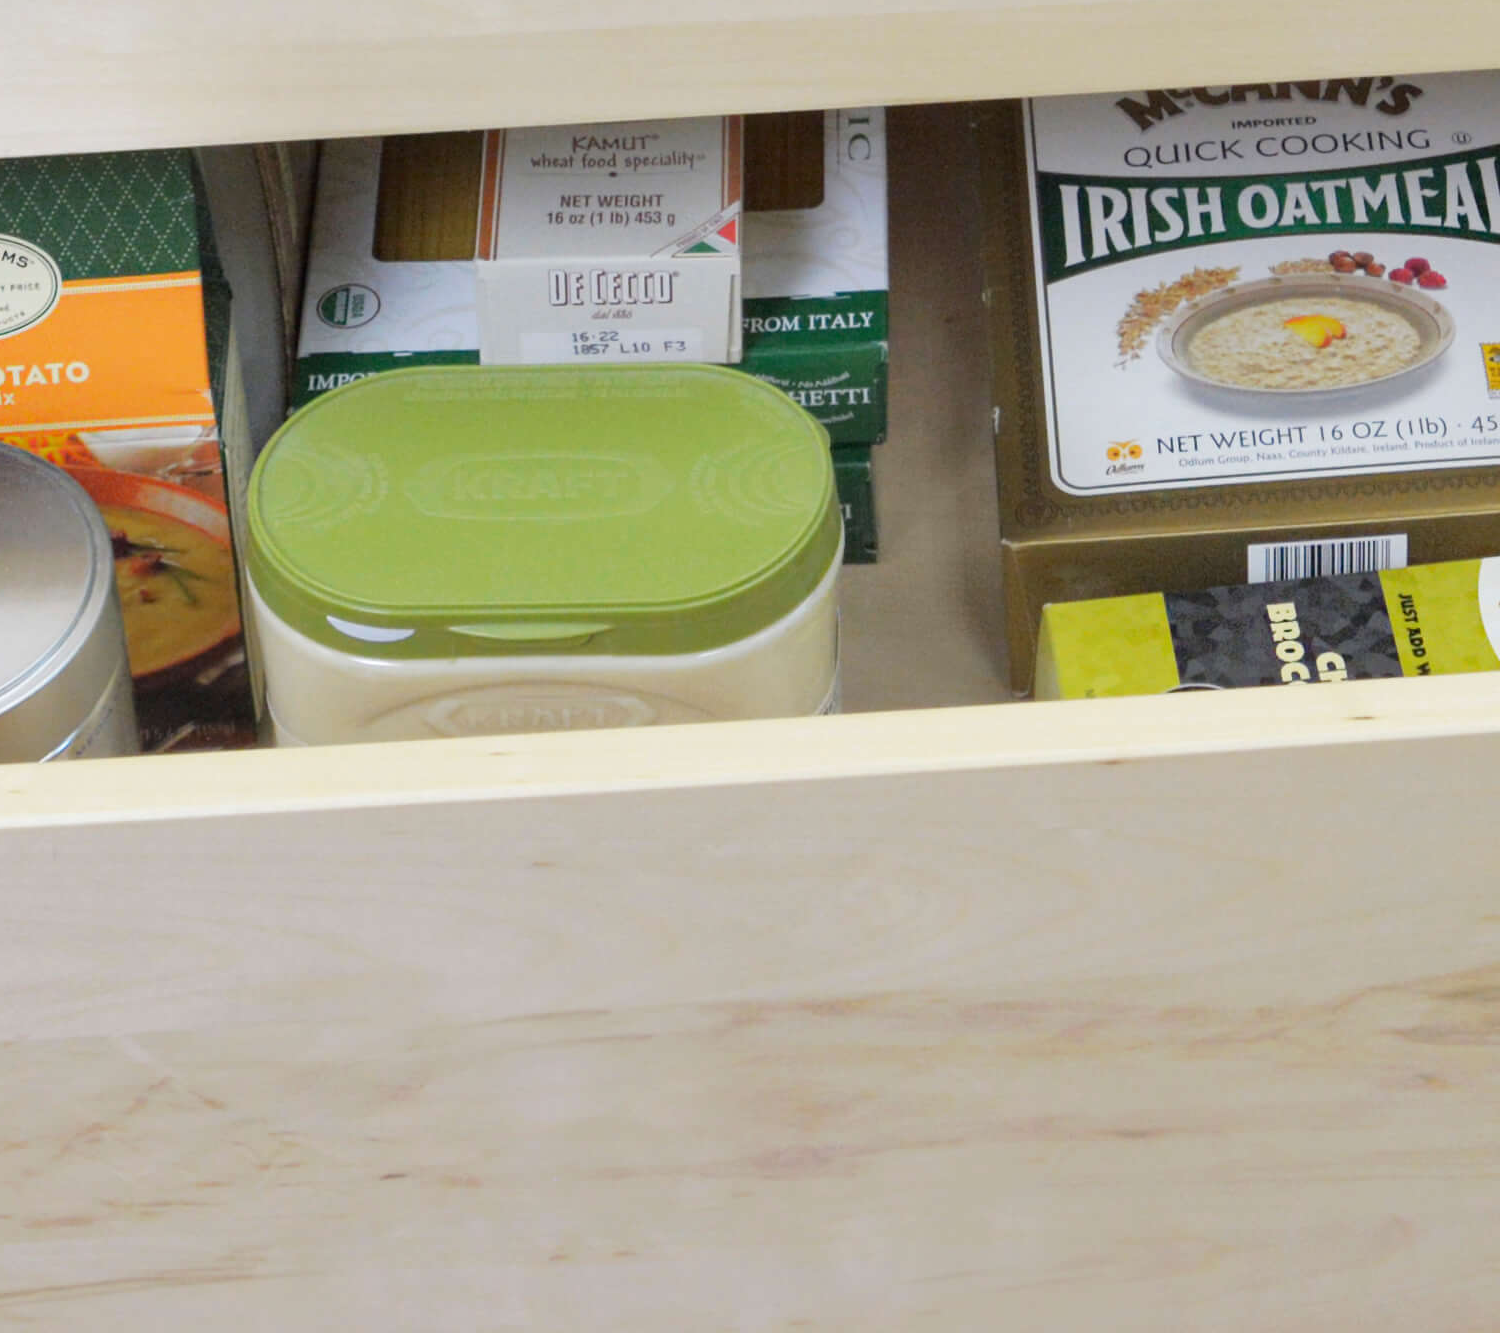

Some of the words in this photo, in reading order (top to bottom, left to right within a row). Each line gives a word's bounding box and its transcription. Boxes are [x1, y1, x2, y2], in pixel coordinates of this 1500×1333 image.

[1231, 115, 1317, 130] IMPORTED
[572, 135, 652, 154] KAMUT
[1123, 140, 1243, 169] QUICK
[1256, 129, 1431, 159] COOKING
[530, 154, 574, 169] wheat
[582, 153, 617, 169] food
[560, 194, 593, 207] NET
[598, 194, 664, 208] WEIGHT
[547, 212, 564, 225] 16
[568, 214, 585, 225] oz
[634, 211, 663, 225] 453
[667, 213, 676, 226] g
[1059, 184, 1227, 269] IRISH
[589, 268, 674, 306] CECCO
[742, 316, 800, 333] FROM
[808, 312, 873, 331] ITALY
[1156, 434, 1203, 454] NET
[1209, 425, 1308, 450] WEIGHT
[1318, 425, 1343, 442] 16
[1352, 420, 1388, 439] OZ
[1179, 456, 1214, 467] Odlum
[1288, 448, 1328, 460] County
[1414, 438, 1454, 450] Product
[1457, 437, 1468, 447] of
[452, 466, 632, 502] KRAFT
[1398, 593, 1418, 624] JUST
[1266, 602, 1311, 684] BROC
[1405, 627, 1427, 659] ADD
